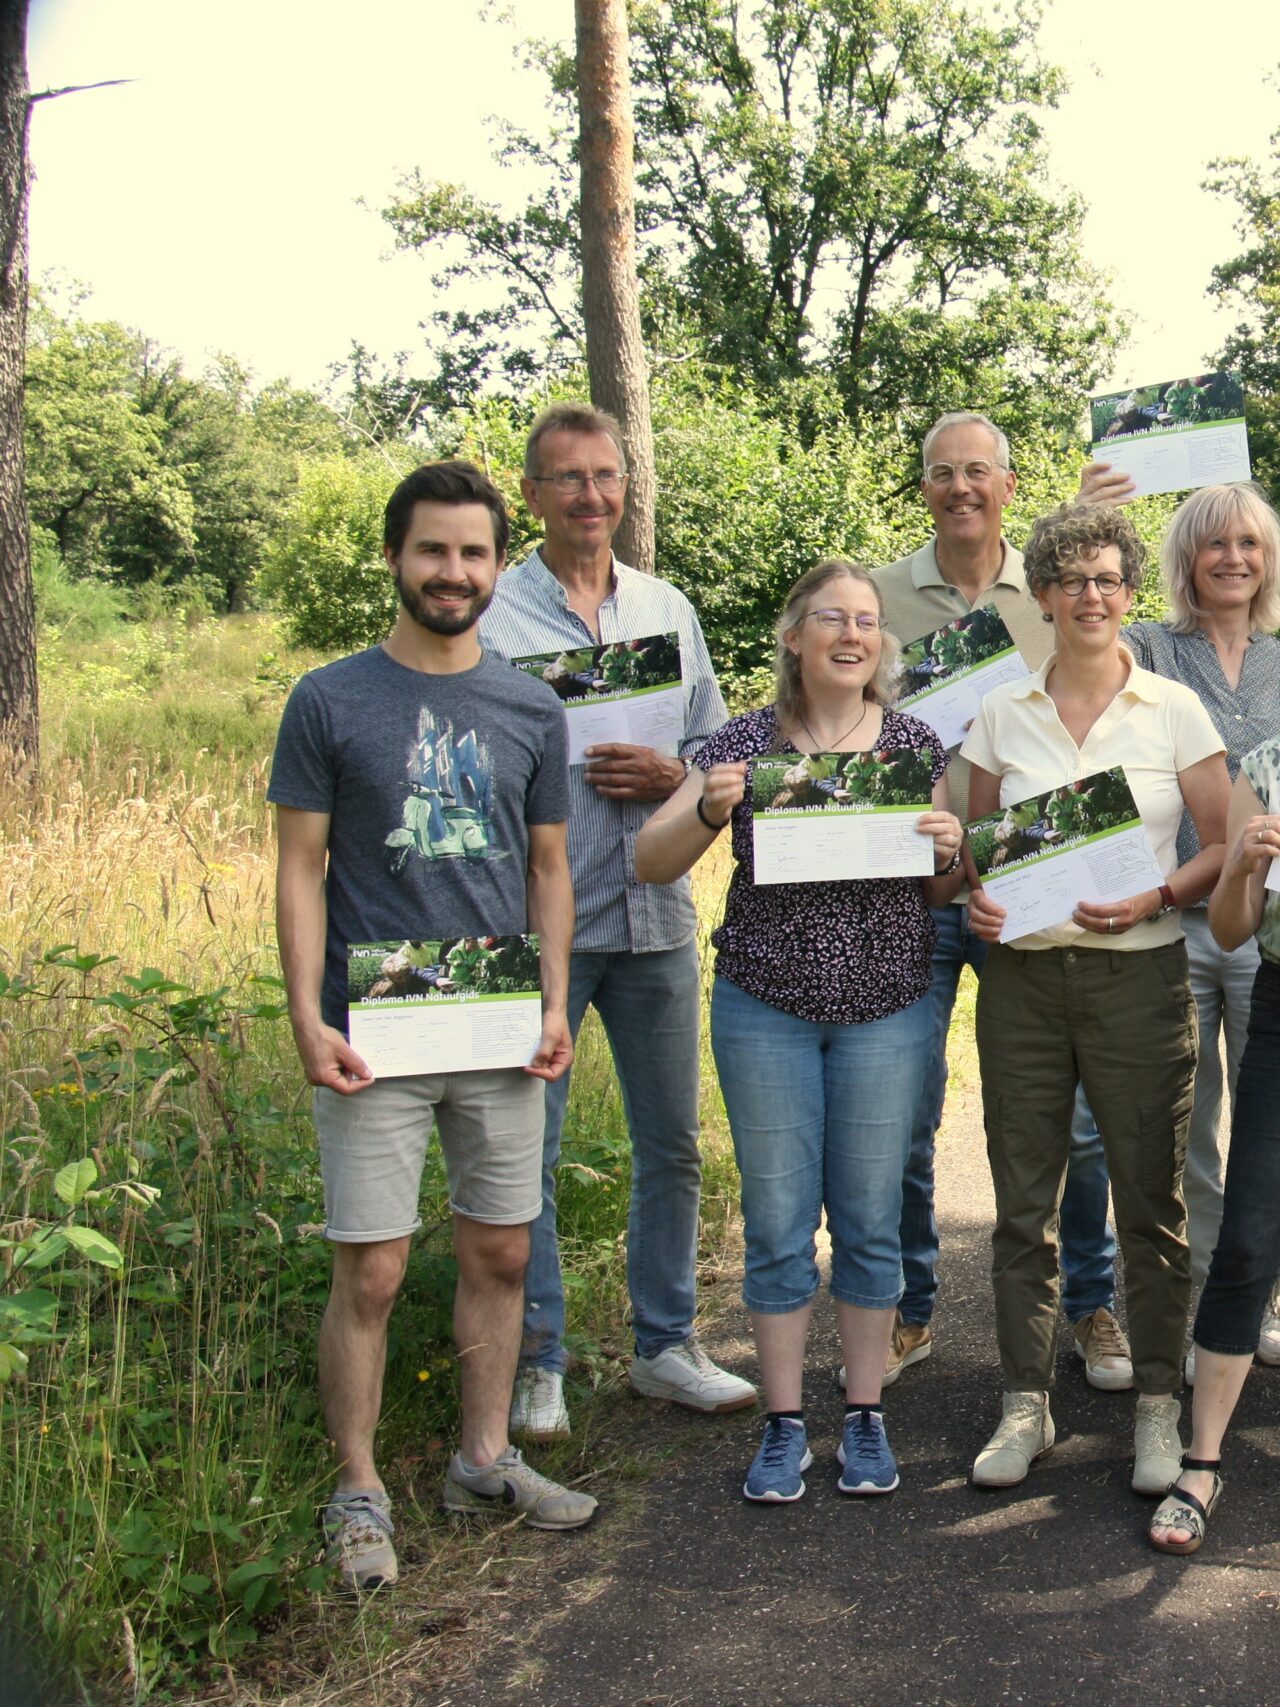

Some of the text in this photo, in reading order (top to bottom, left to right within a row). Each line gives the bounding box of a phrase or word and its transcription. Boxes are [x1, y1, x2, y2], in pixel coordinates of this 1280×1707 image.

[1100, 433, 1132, 444] Diploma
[1150, 422, 1193, 433] Natuurgids
[916, 685, 930, 697] IVN
[930, 664, 971, 688] Natuurgids
[566, 695, 583, 704] IVN
[584, 688, 632, 702] Natuurgids
[764, 802, 874, 816] Diploma IVN Natuurgids
[987, 834, 1087, 876] Diploma IVN Natuurgids
[361, 990, 480, 1007] Diploma IVN Natuurgids
